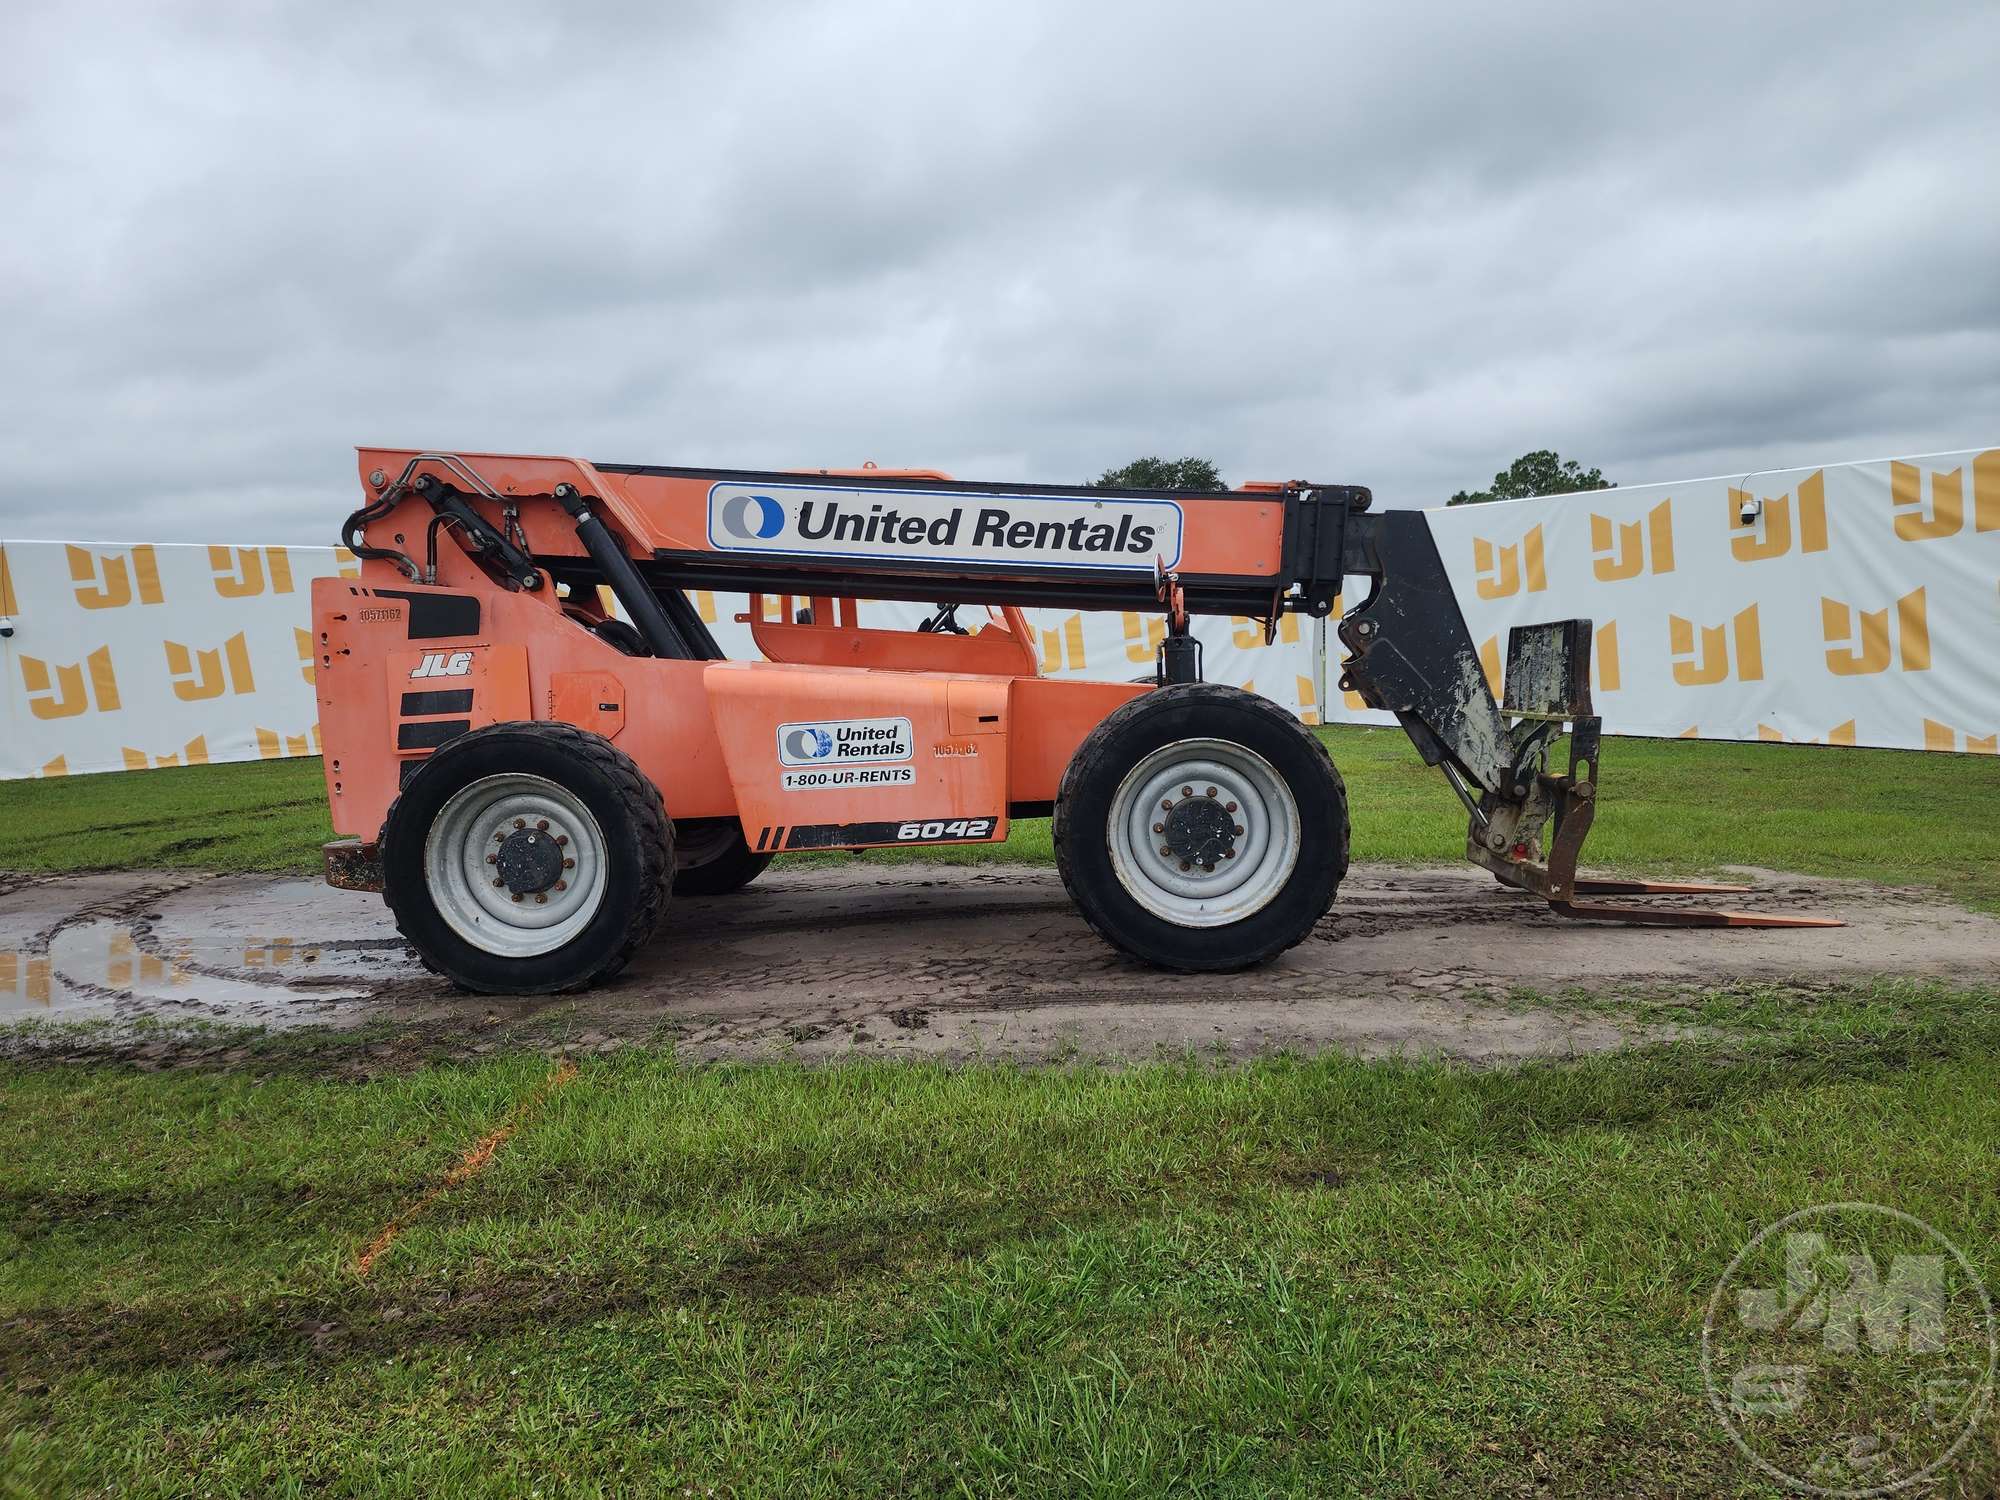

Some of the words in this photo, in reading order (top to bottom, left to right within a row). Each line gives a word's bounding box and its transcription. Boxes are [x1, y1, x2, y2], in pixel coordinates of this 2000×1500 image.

[797, 501, 964, 546] United
[972, 508, 1156, 554] Rentals
[409, 651, 474, 679] JLG
[836, 725, 899, 742] United
[837, 740, 905, 757] Rentals
[785, 768, 912, 787] 1-800-UR-RENTS
[896, 820, 990, 841] 6042
